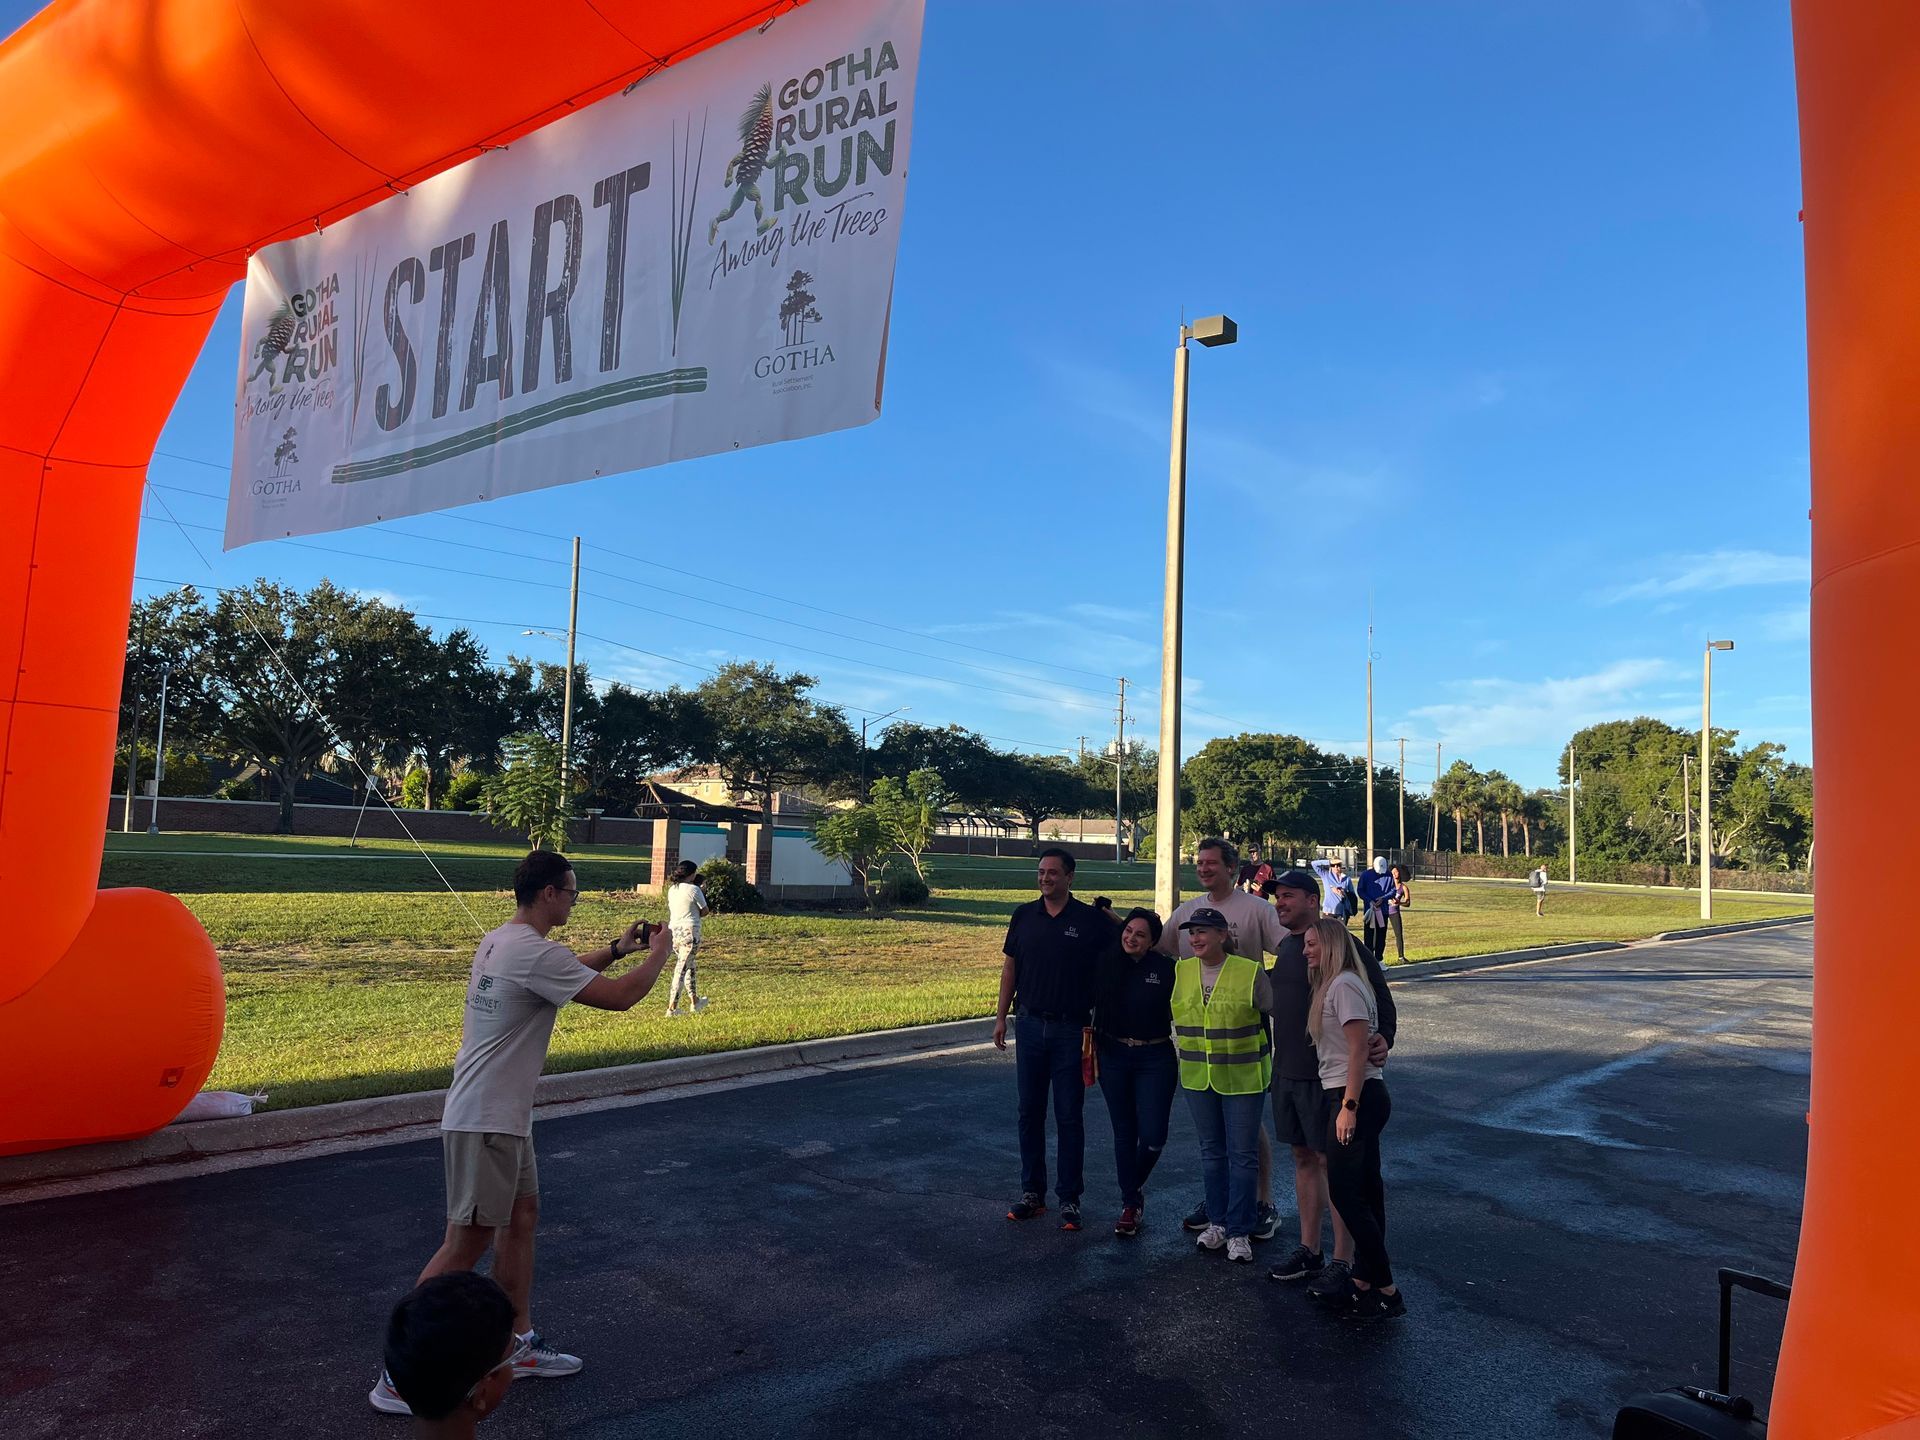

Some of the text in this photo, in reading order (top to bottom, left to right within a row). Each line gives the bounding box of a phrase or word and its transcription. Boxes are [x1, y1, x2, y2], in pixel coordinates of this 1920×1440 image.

[778, 41, 899, 111] GOTHA
[775, 81, 898, 150] RURAL
[774, 119, 896, 212] RUN
[709, 192, 888, 290] Among the Trees
[291, 272, 340, 318] GOTHA
[375, 162, 651, 432] START
[282, 328, 338, 383] RUN
[754, 344, 836, 378] GOTHA
[290, 387, 312, 410] the
[252, 480, 301, 496] GOTHA
